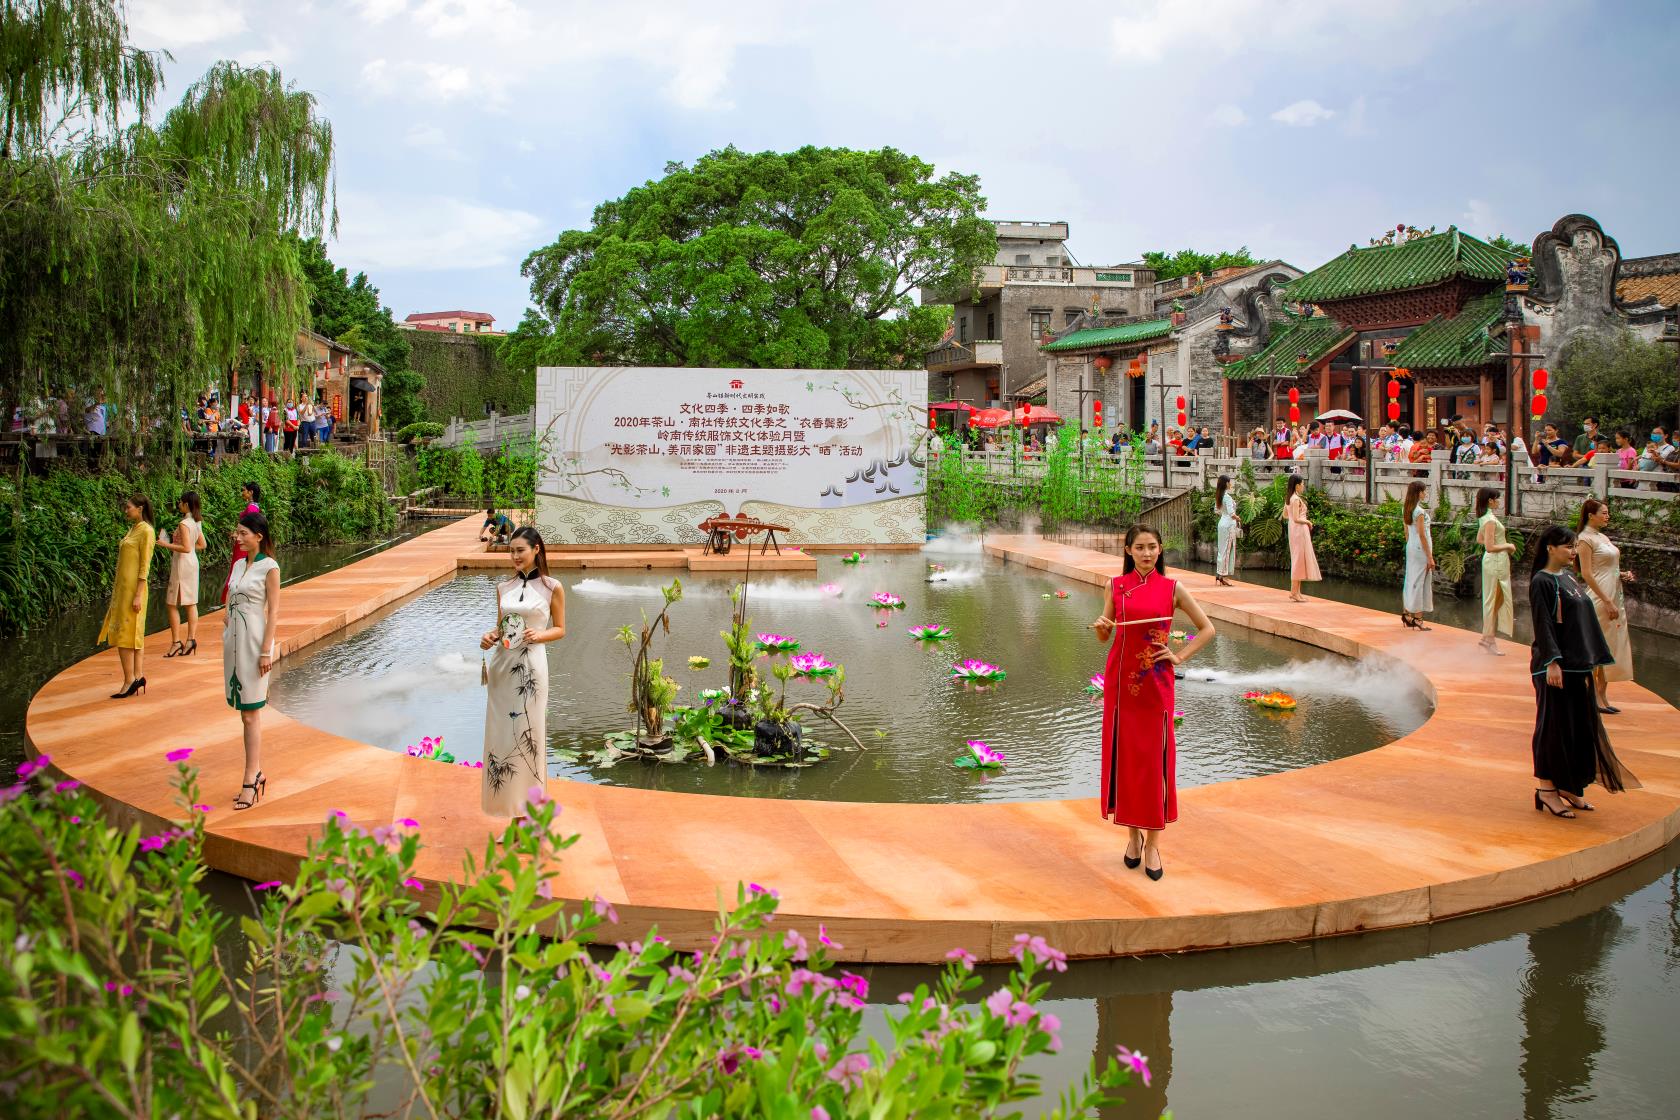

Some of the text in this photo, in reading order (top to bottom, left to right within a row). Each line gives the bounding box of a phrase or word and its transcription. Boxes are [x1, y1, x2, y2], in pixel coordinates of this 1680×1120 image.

[679, 402, 790, 415] 文化四季·四季如歌
[657, 430, 806, 442] 岭南传统服饰文化体验月暨
